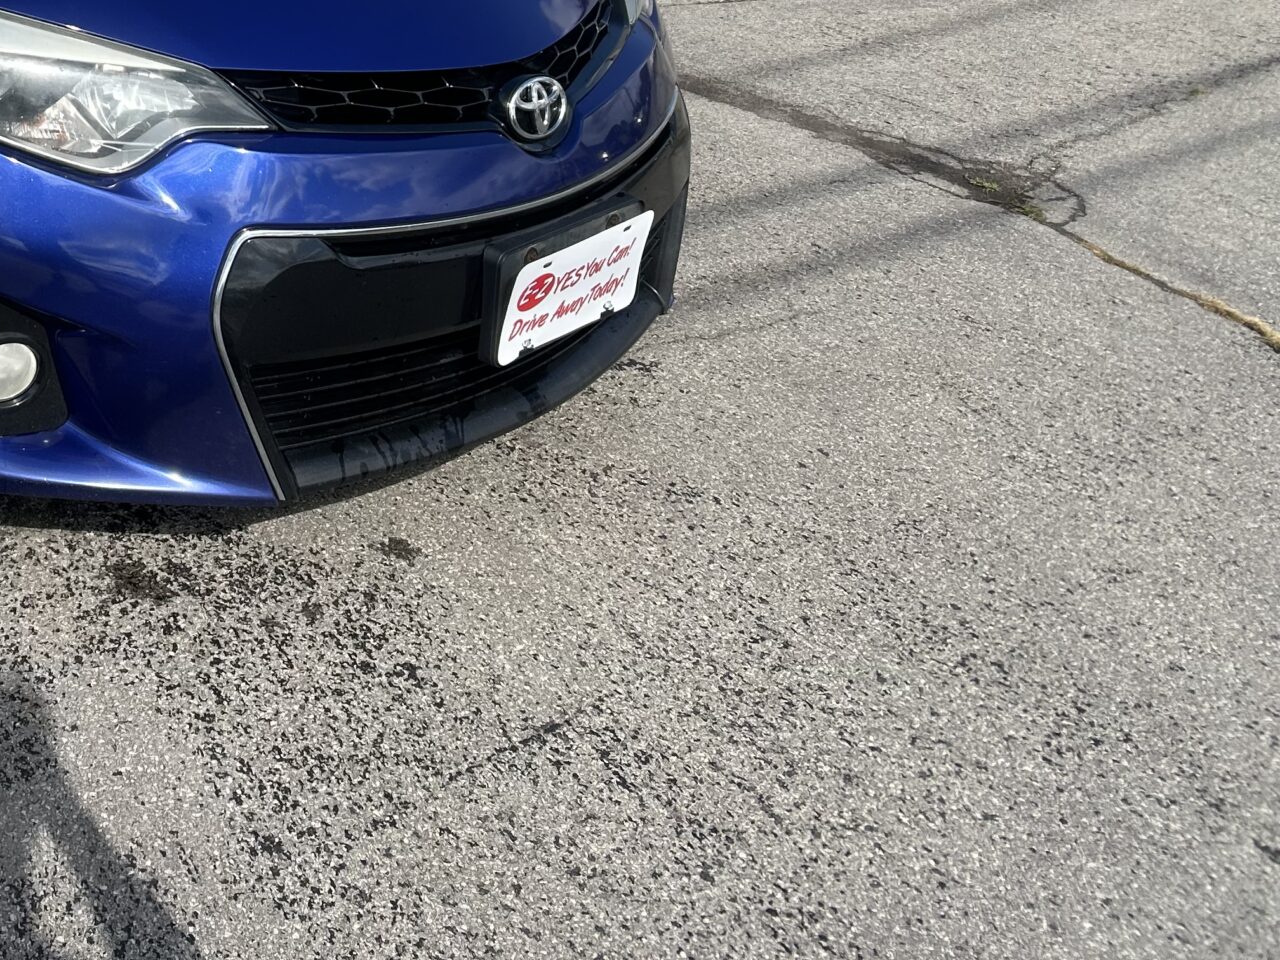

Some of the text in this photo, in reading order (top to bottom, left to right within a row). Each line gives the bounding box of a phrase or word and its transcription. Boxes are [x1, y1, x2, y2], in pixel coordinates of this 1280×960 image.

[553, 265, 586, 295] YES
[583, 257, 607, 280] You
[607, 237, 637, 267] Can!
[508, 267, 631, 342] Drive Away Today!
